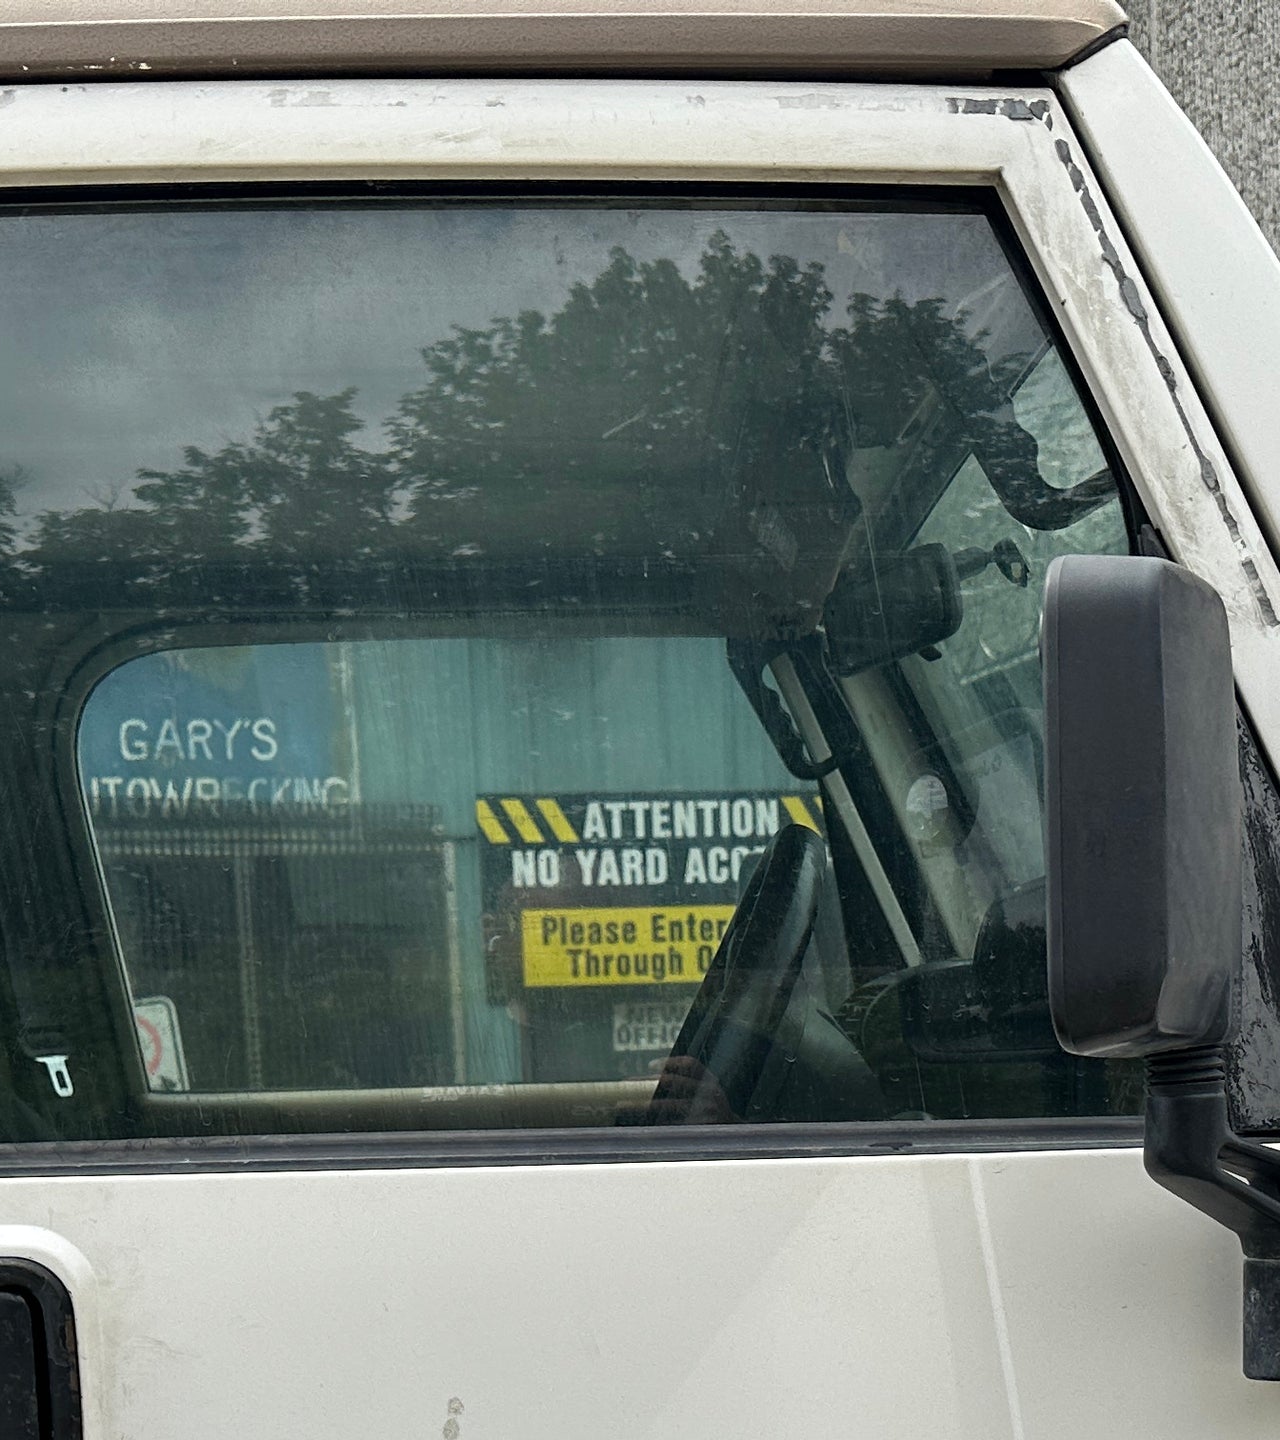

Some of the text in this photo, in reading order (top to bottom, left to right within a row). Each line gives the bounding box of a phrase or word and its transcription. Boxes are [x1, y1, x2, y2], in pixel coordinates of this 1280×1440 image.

[120, 718, 278, 761] GARY'S
[584, 799, 779, 839] ATTENTION
[511, 850, 560, 888] NO
[576, 848, 669, 886] YARD
[540, 912, 729, 946] Please Enter
[567, 950, 683, 979] Through
